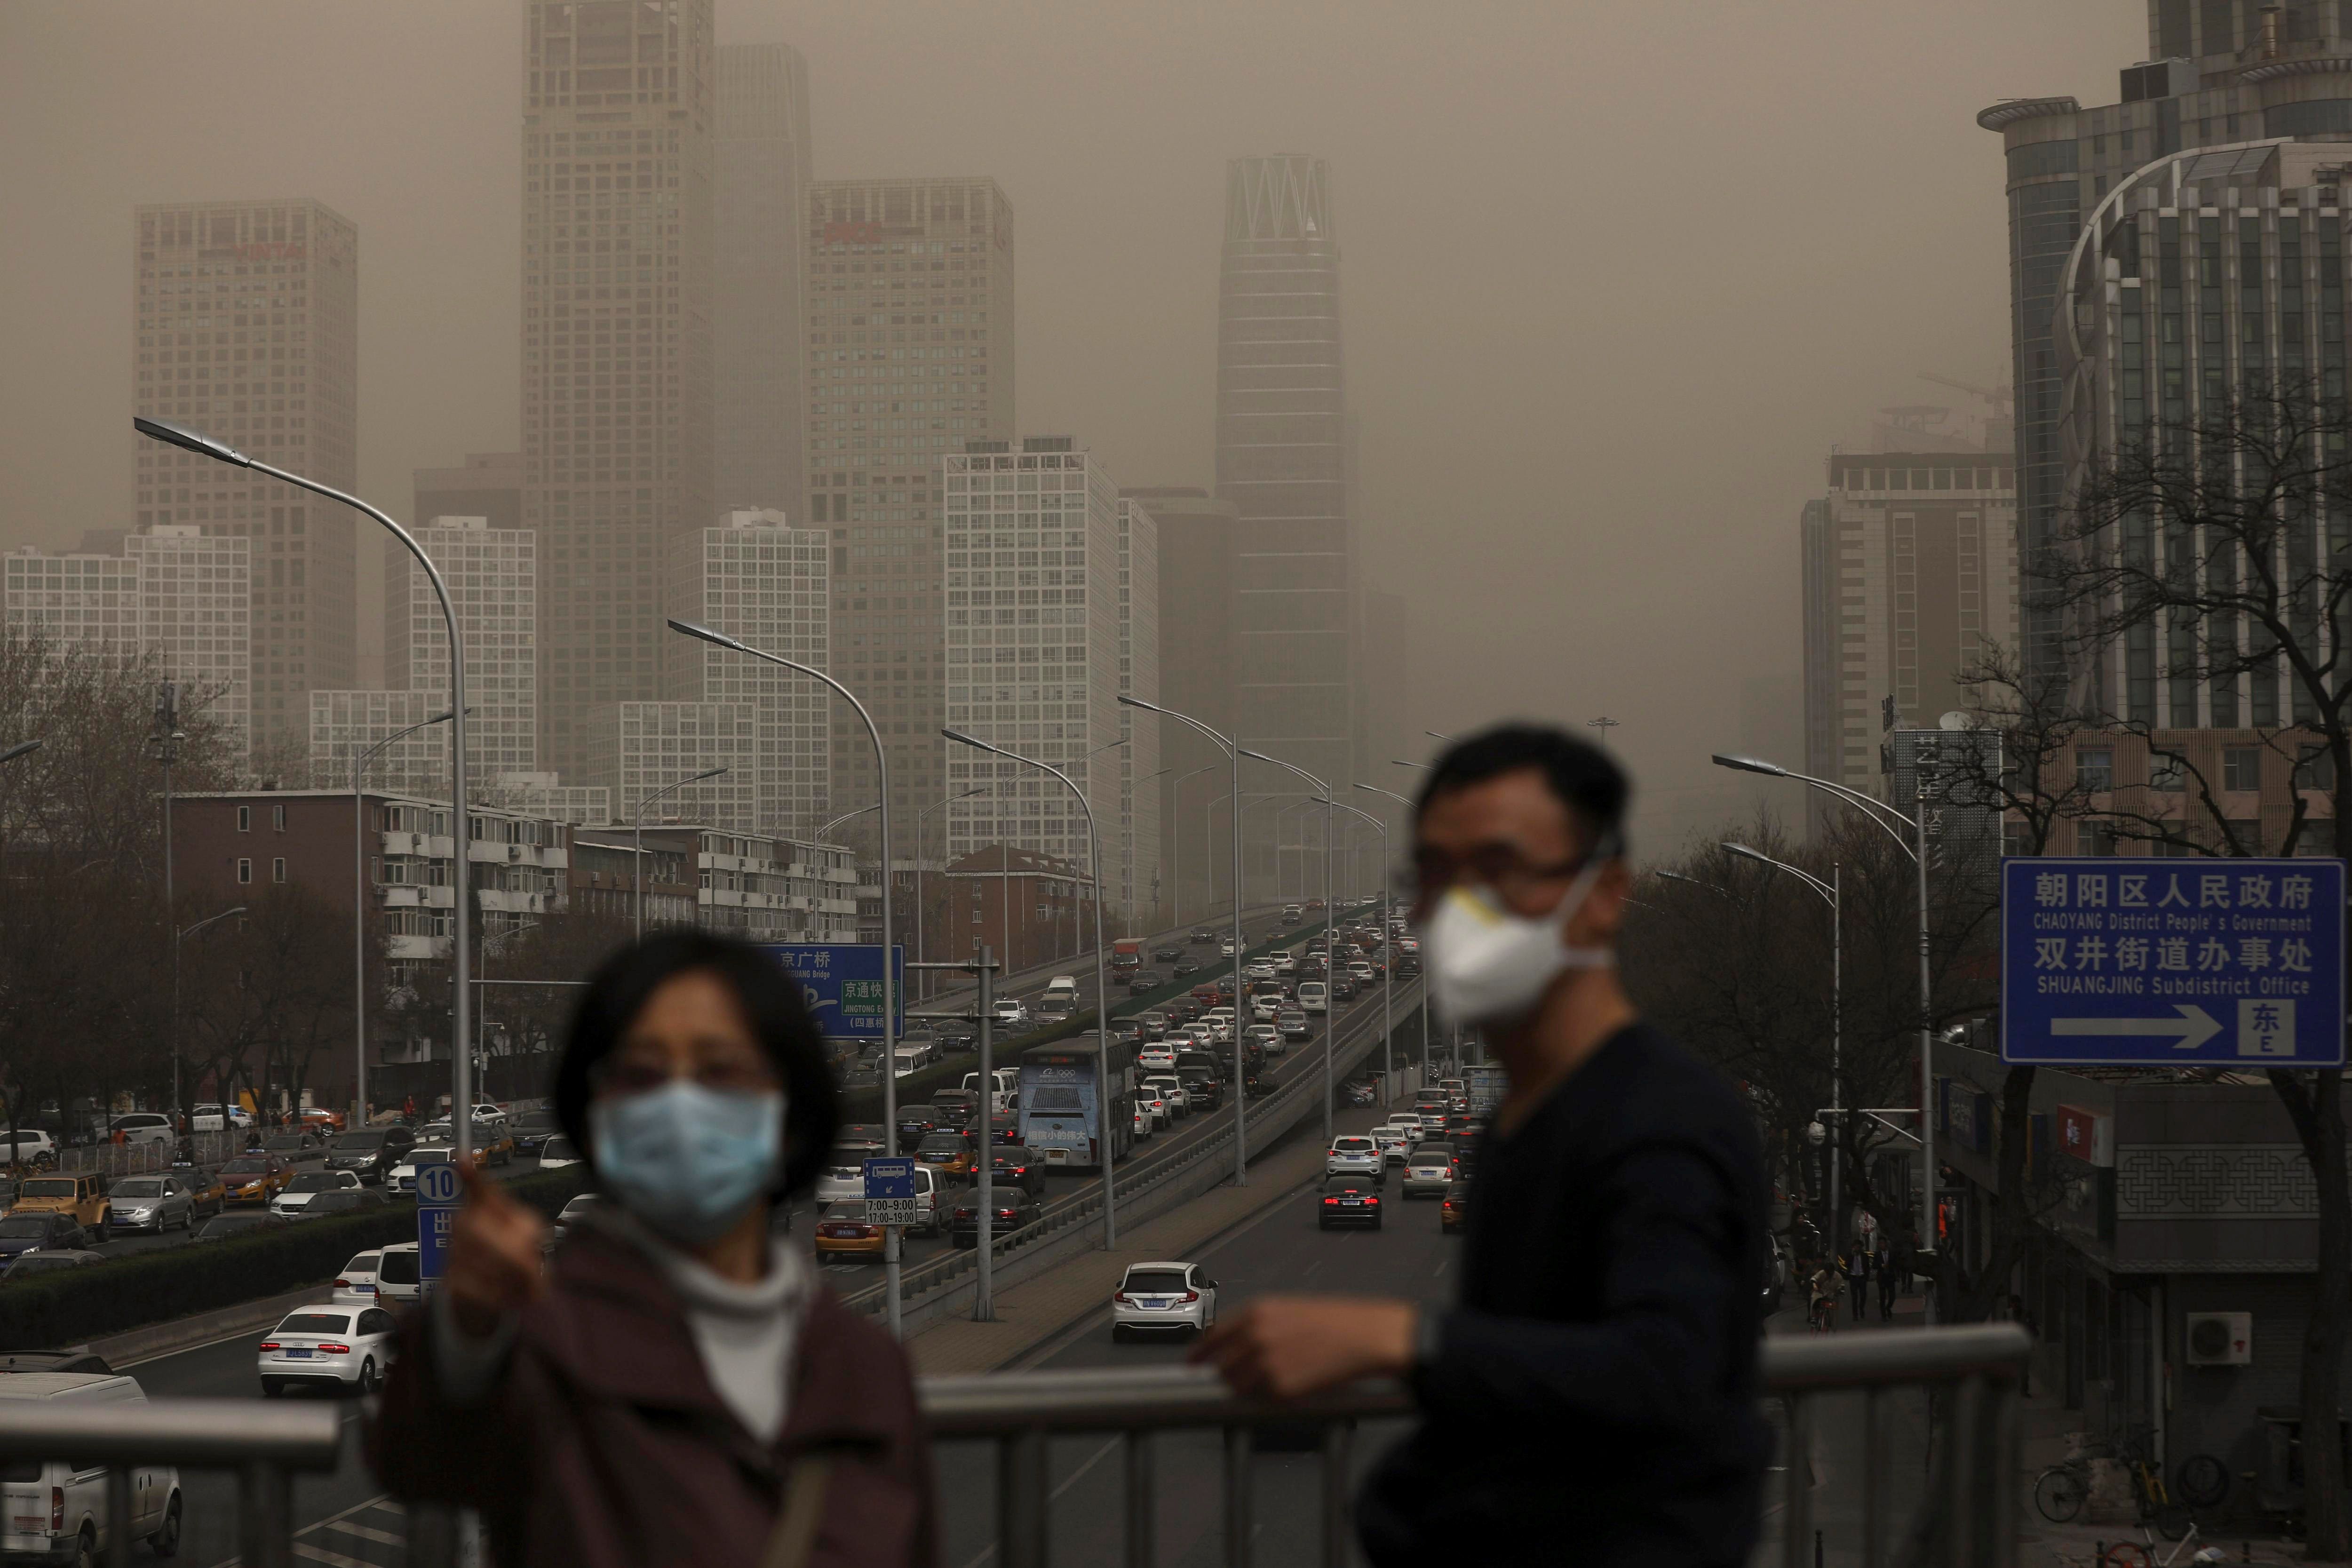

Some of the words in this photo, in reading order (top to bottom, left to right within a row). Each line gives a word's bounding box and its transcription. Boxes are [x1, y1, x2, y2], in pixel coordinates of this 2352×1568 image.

[2034, 872, 2312, 909] 朝阳区人民政府
[2034, 913, 2103, 930] CHAOYANG
[2109, 913, 2160, 930] District
[2233, 914, 2312, 932] Government
[780, 951, 830, 968] 京广桥
[2034, 936, 2312, 972] 双井街道办事处
[813, 970, 830, 980] Bridge
[2037, 976, 2144, 994] SHUANGJING
[2152, 976, 2250, 995] Subdistrict
[2260, 976, 2310, 995] Office
[2251, 1003, 2280, 1033] 东
[2260, 1035, 2273, 1052] E
[1028, 1130, 1086, 1140] 相信小的伟大
[426, 1170, 453, 1198] 10
